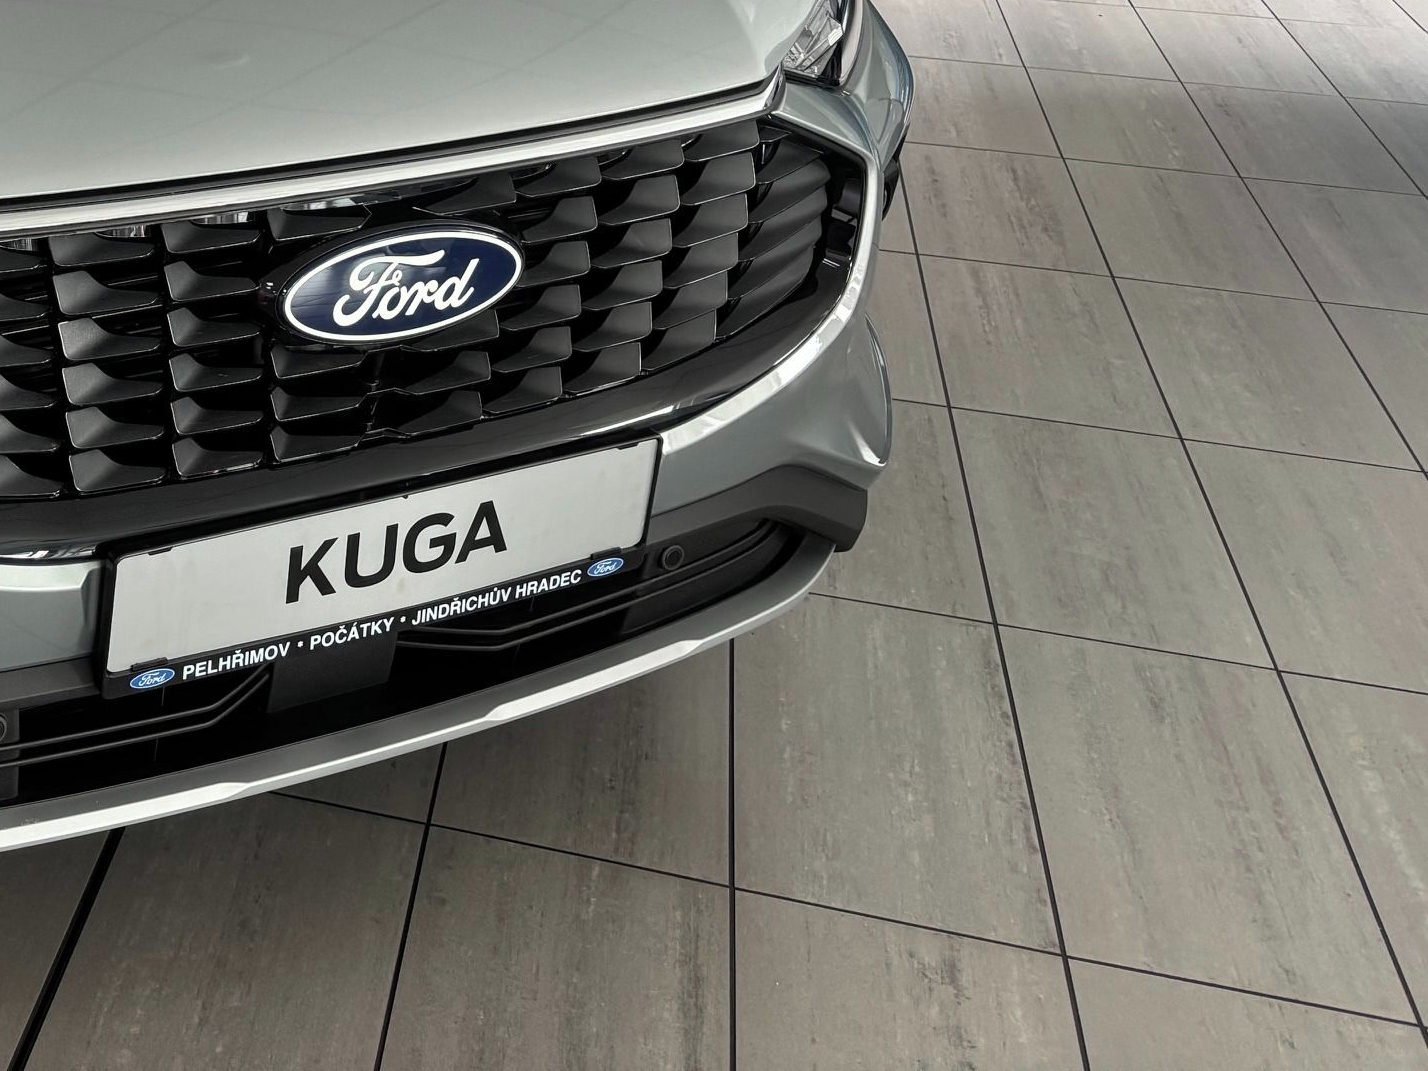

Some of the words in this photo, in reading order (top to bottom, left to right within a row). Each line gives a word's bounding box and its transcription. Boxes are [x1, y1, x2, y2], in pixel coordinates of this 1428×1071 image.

[332, 249, 480, 327] Ford
[285, 500, 508, 604] KUGA
[182, 642, 290, 680] PELHŘIMOV
[309, 617, 395, 650] POČÁTKY
[411, 587, 512, 625] JINDŘICHŮV
[515, 569, 582, 598] HRADEC
